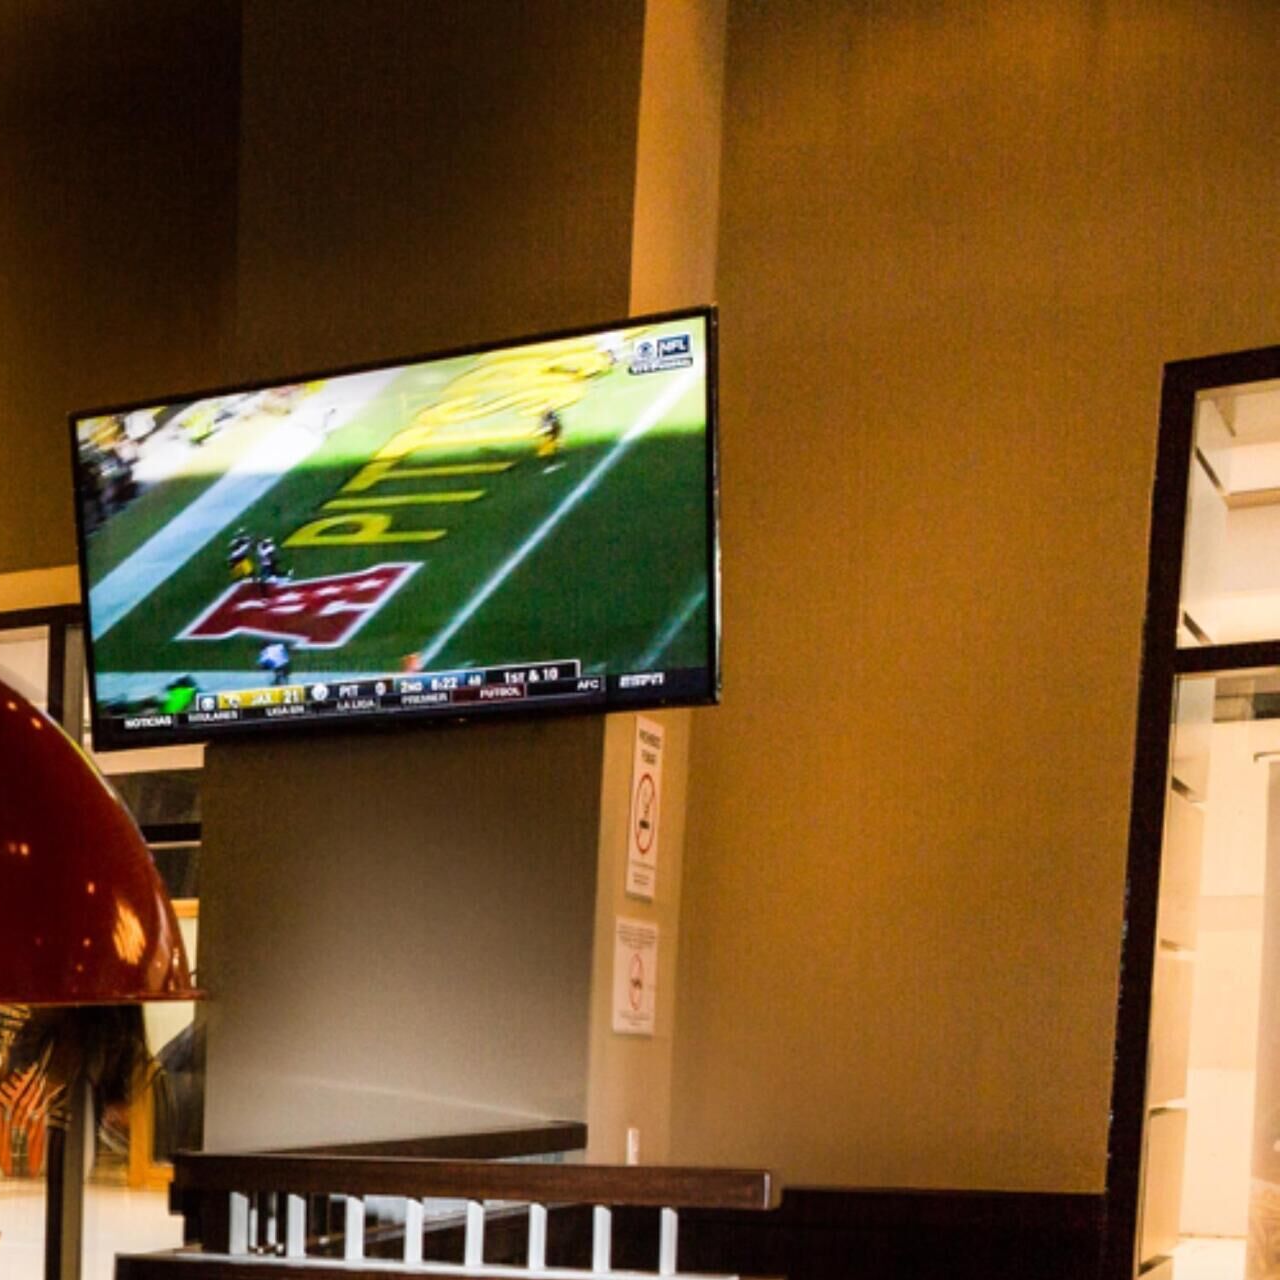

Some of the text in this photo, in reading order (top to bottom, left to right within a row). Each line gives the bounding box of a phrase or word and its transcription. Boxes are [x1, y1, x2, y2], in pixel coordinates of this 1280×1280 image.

[659, 338, 688, 353] NFL
[339, 685, 358, 699] PIT
[528, 670, 539, 682] &
[543, 667, 559, 681] 10
[619, 672, 664, 688] ESPN
[124, 715, 172, 729] NOTICIAS
[577, 679, 599, 691] AFC
